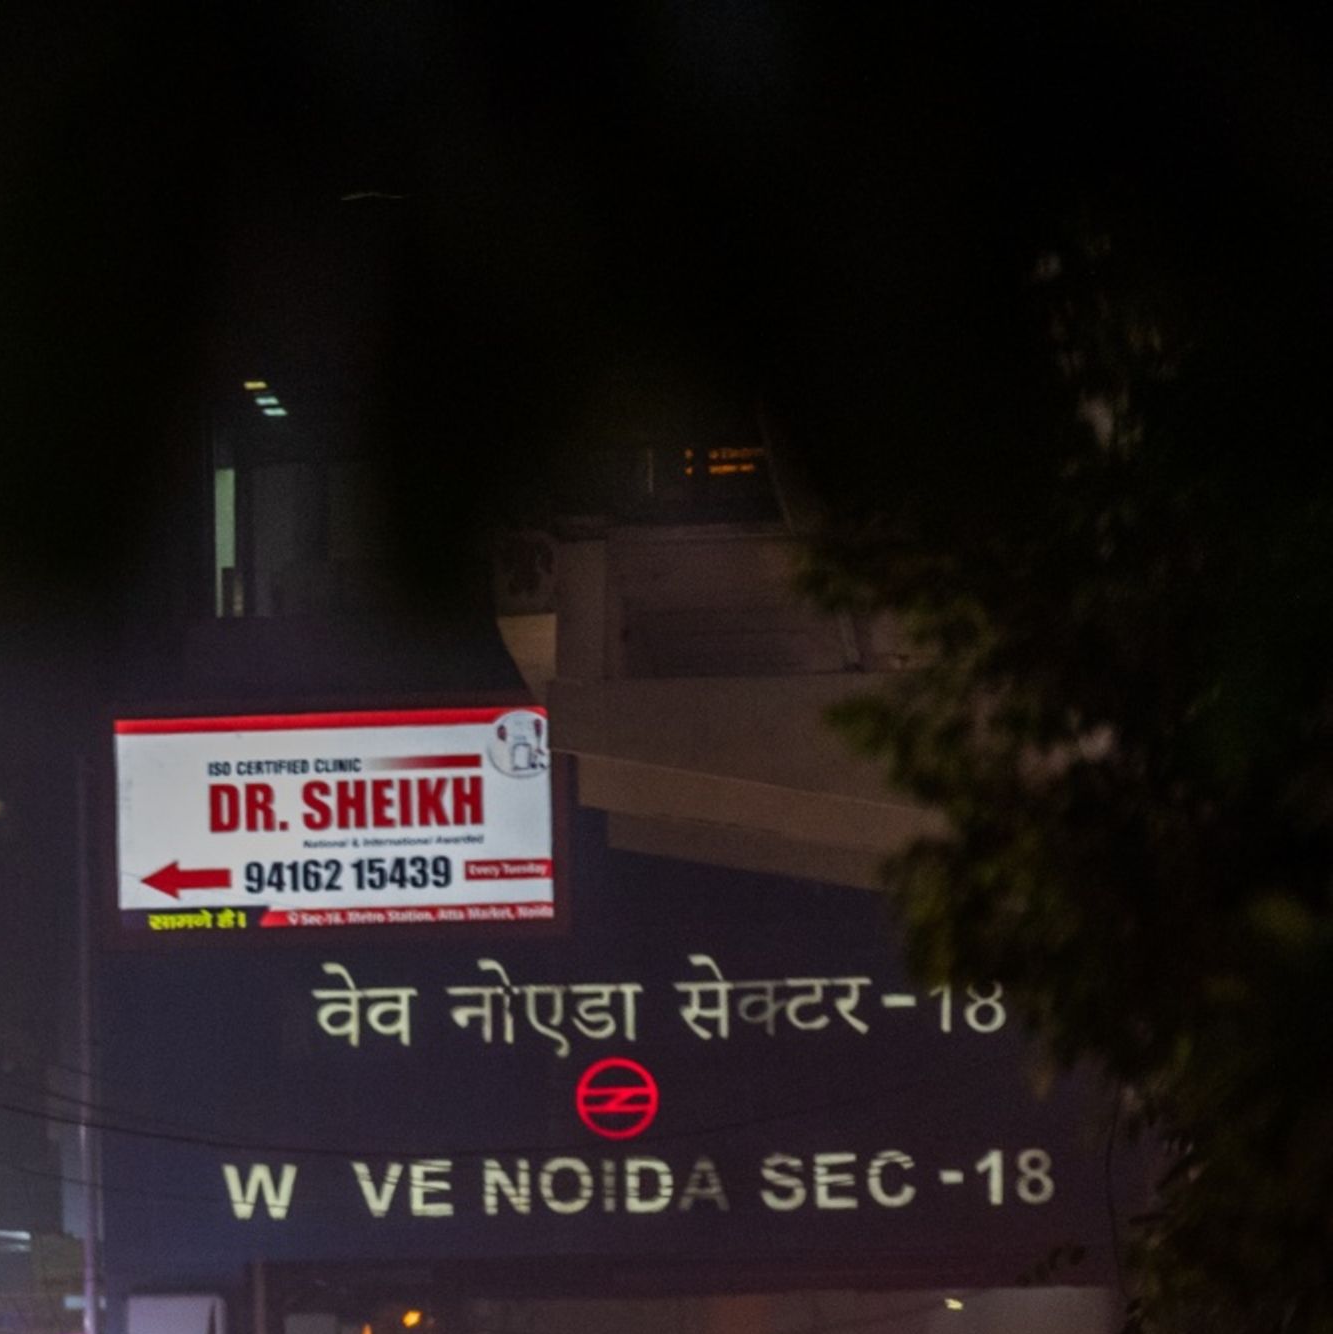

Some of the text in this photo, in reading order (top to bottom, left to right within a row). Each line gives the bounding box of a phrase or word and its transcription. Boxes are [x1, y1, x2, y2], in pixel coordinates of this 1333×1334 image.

[208, 757, 363, 776] ISO CERTIFIED CLINIC
[209, 776, 484, 832] DR. SHEIKH
[245, 856, 452, 893] 94162 15439
[312, 963, 418, 1047] वेव
[447, 958, 643, 1057] नोएडा
[483, 1154, 731, 1216] NOIDA
